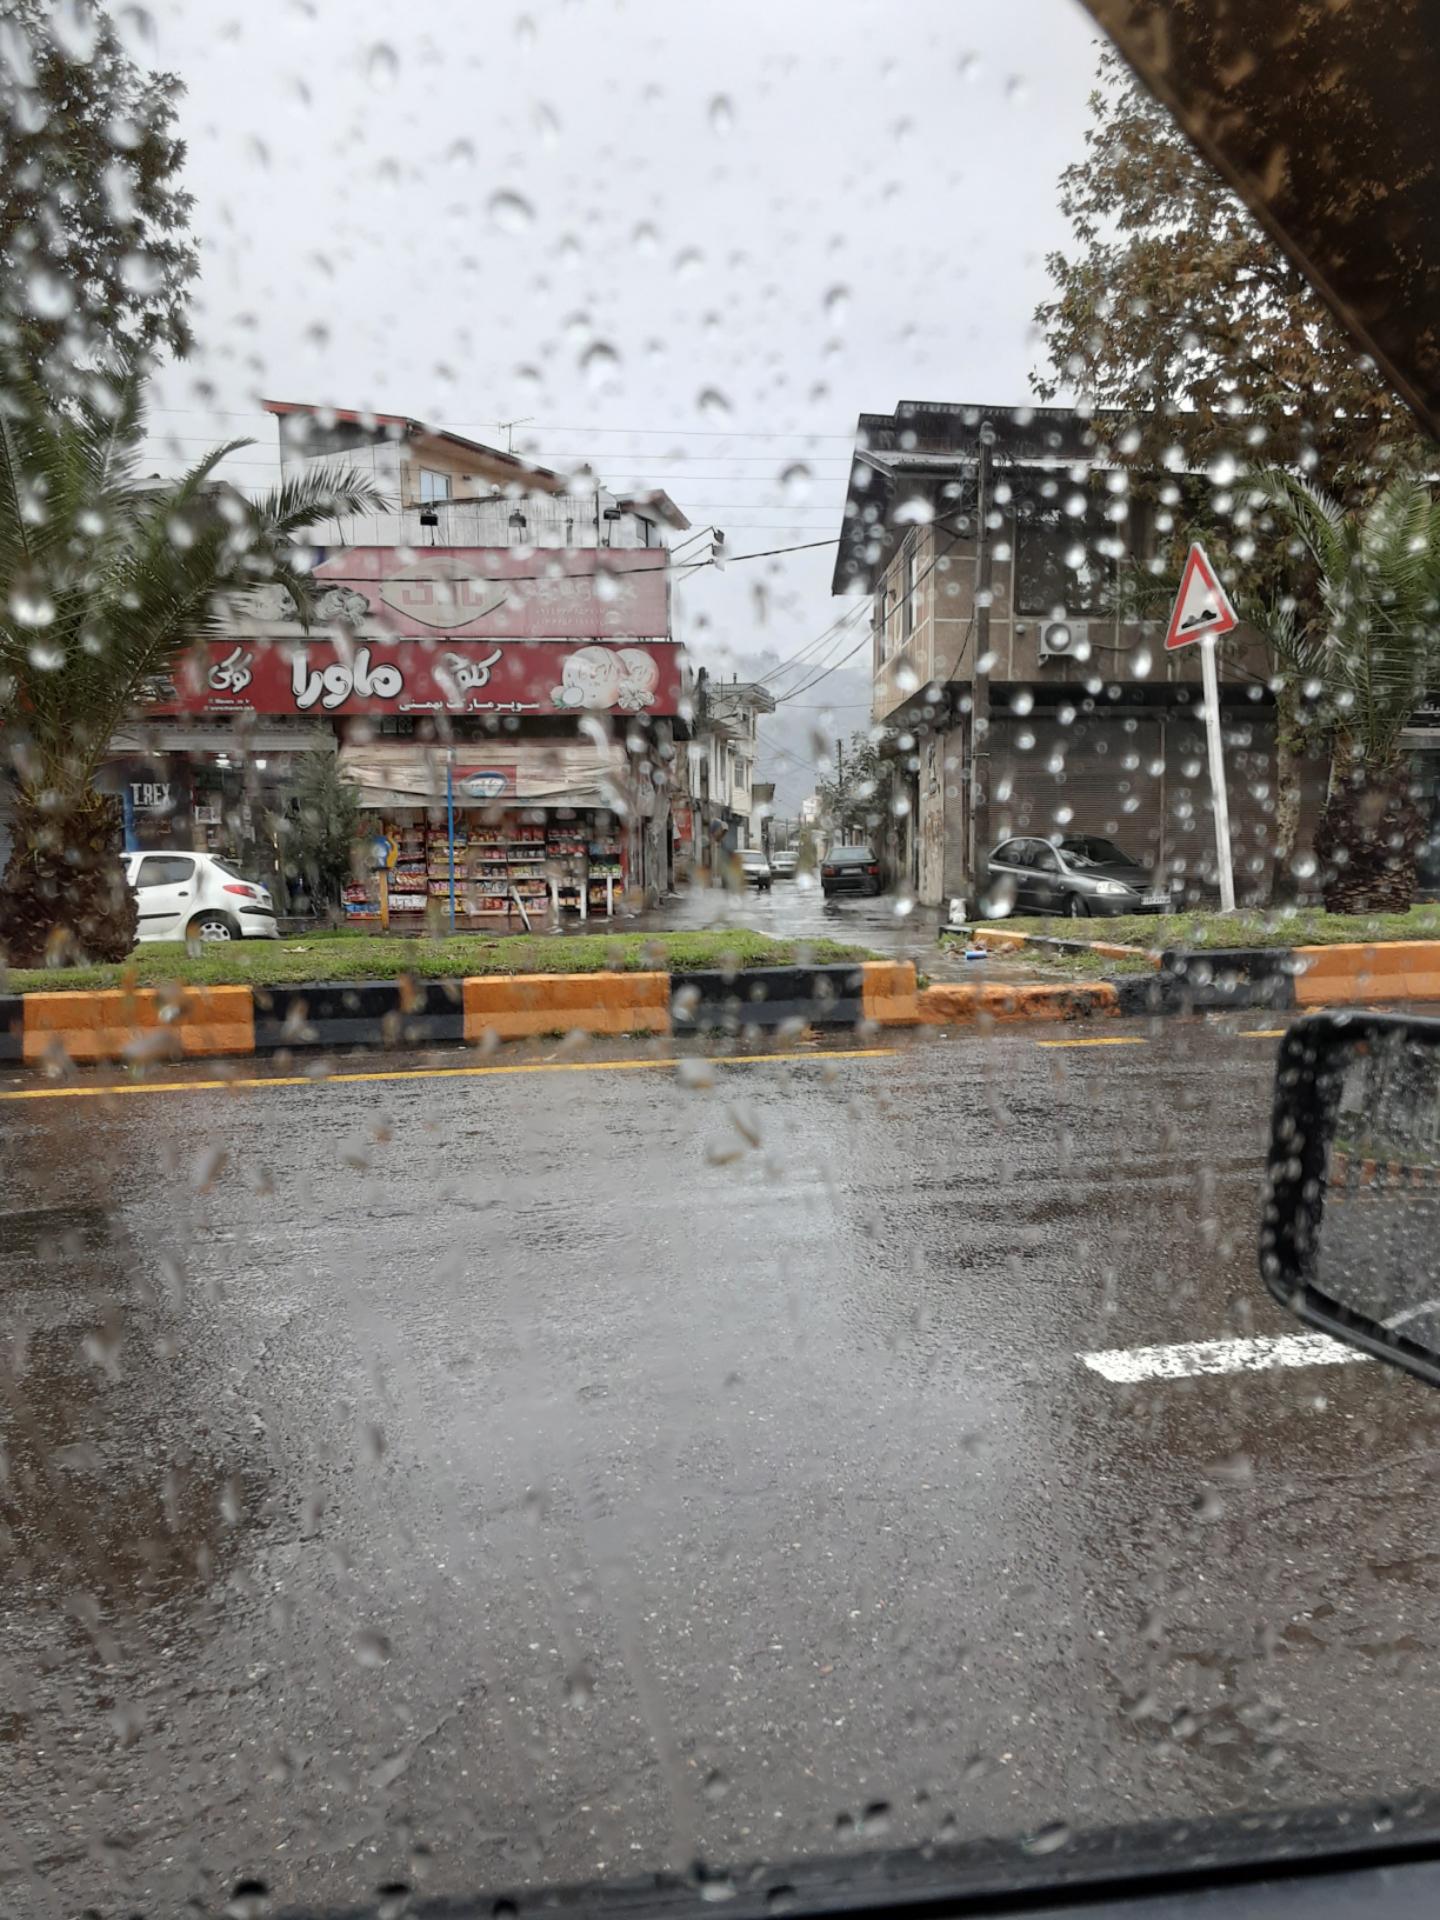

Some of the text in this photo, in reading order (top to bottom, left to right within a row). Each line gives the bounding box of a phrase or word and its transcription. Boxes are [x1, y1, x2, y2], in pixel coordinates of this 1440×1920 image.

[291, 646, 404, 710] ماورا
[438, 648, 504, 691] کلو
[398, 698, 444, 712] بهمنی
